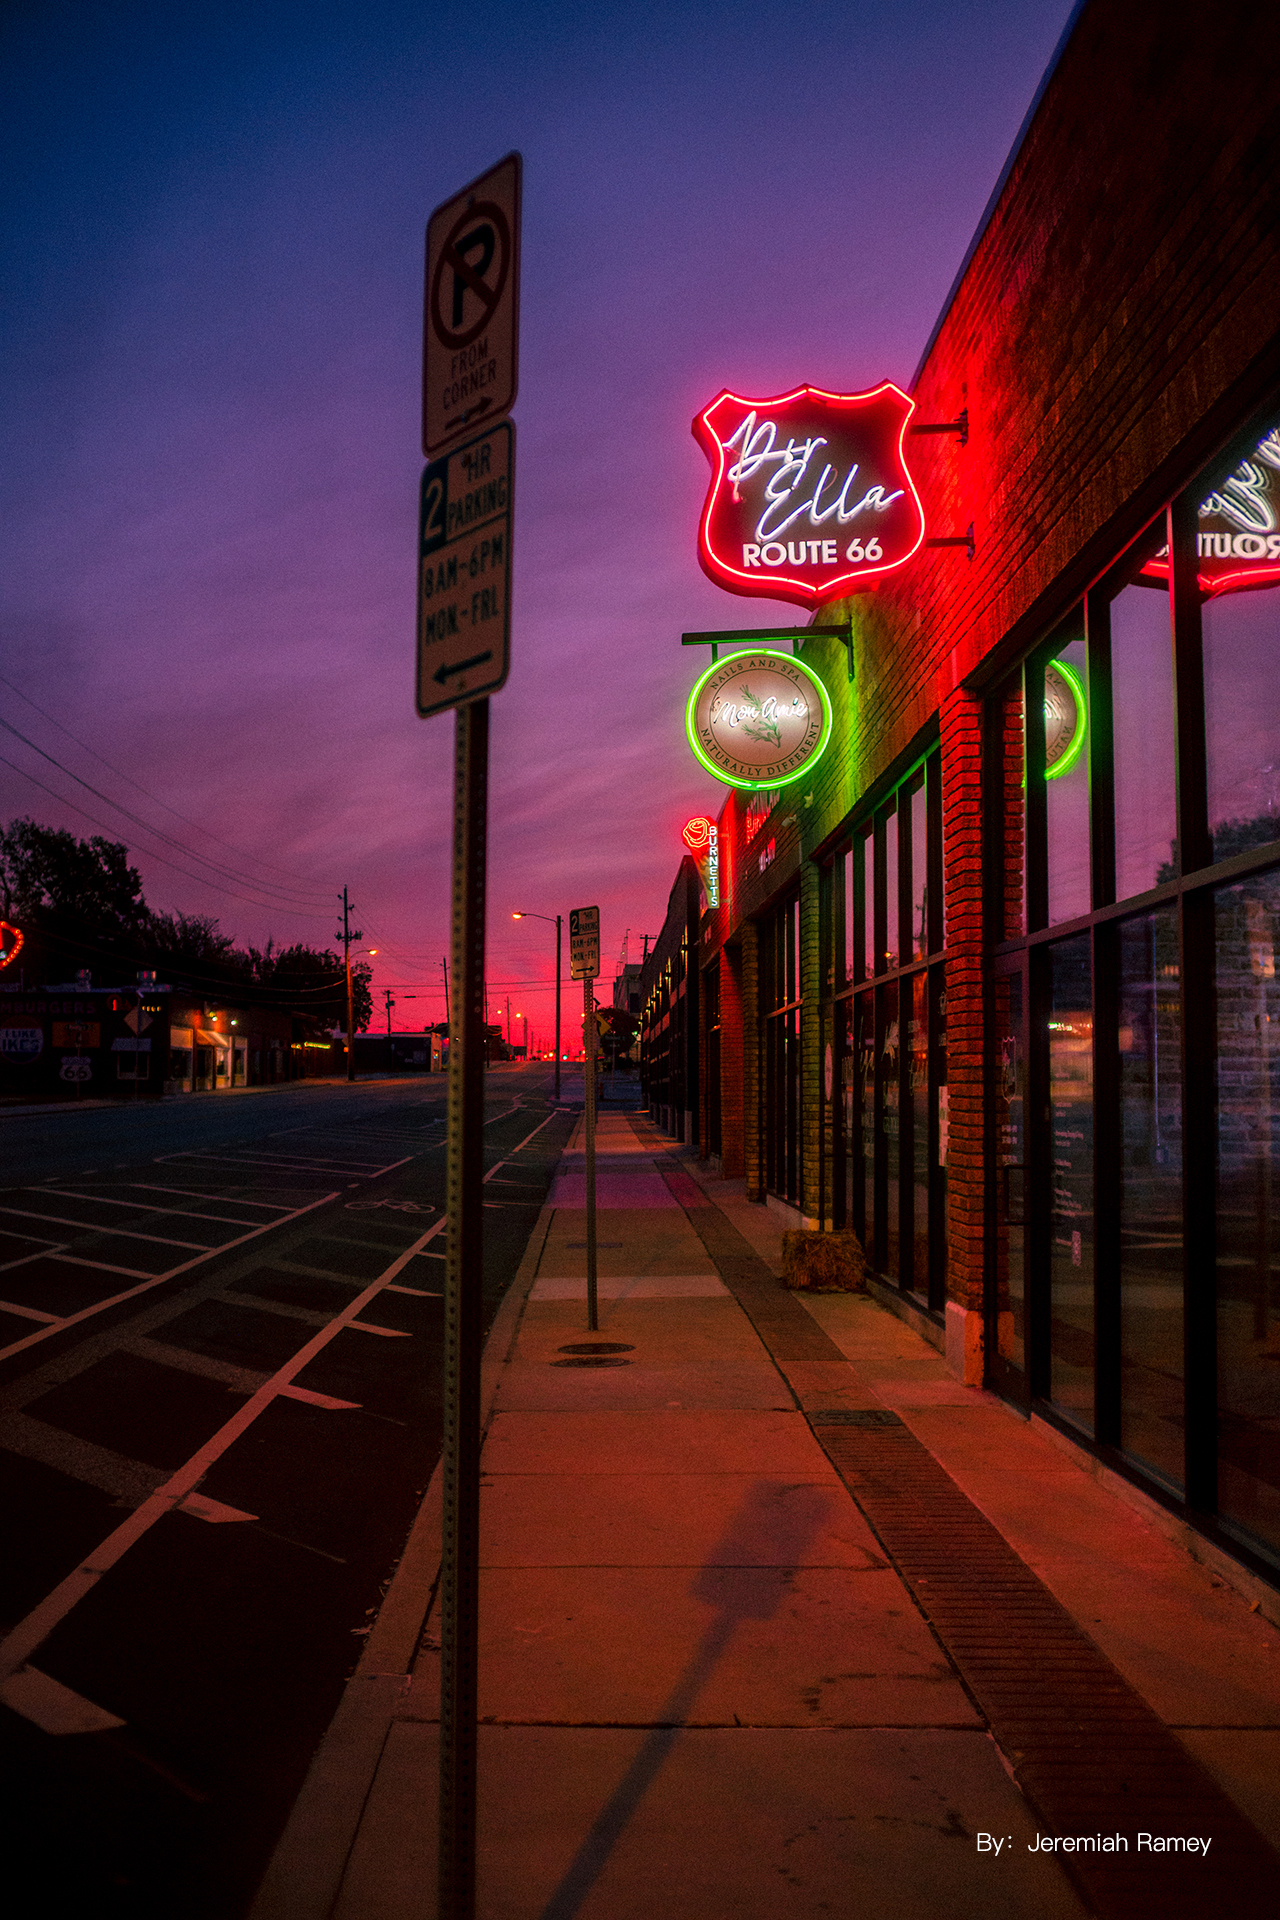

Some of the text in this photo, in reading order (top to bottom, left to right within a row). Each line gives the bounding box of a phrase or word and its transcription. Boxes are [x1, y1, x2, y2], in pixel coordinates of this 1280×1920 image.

[451, 339, 489, 379] FROM
[443, 358, 497, 410] CORNER
[424, 442, 491, 541] 2 HR
[448, 475, 507, 532] PARKING
[755, 458, 904, 543] Ella
[742, 537, 883, 568] ROUTE 66
[710, 659, 800, 690] NAILS AND SPA
[712, 699, 760, 728] Mon
[701, 722, 819, 776] NATURALLY DIFFERENT
[708, 826, 718, 907] BURNETTS
[571, 914, 578, 933] 2
[580, 922, 598, 931] PARKING
[12, 1030, 36, 1038] LIKE
[64, 1065, 87, 1079] 66
